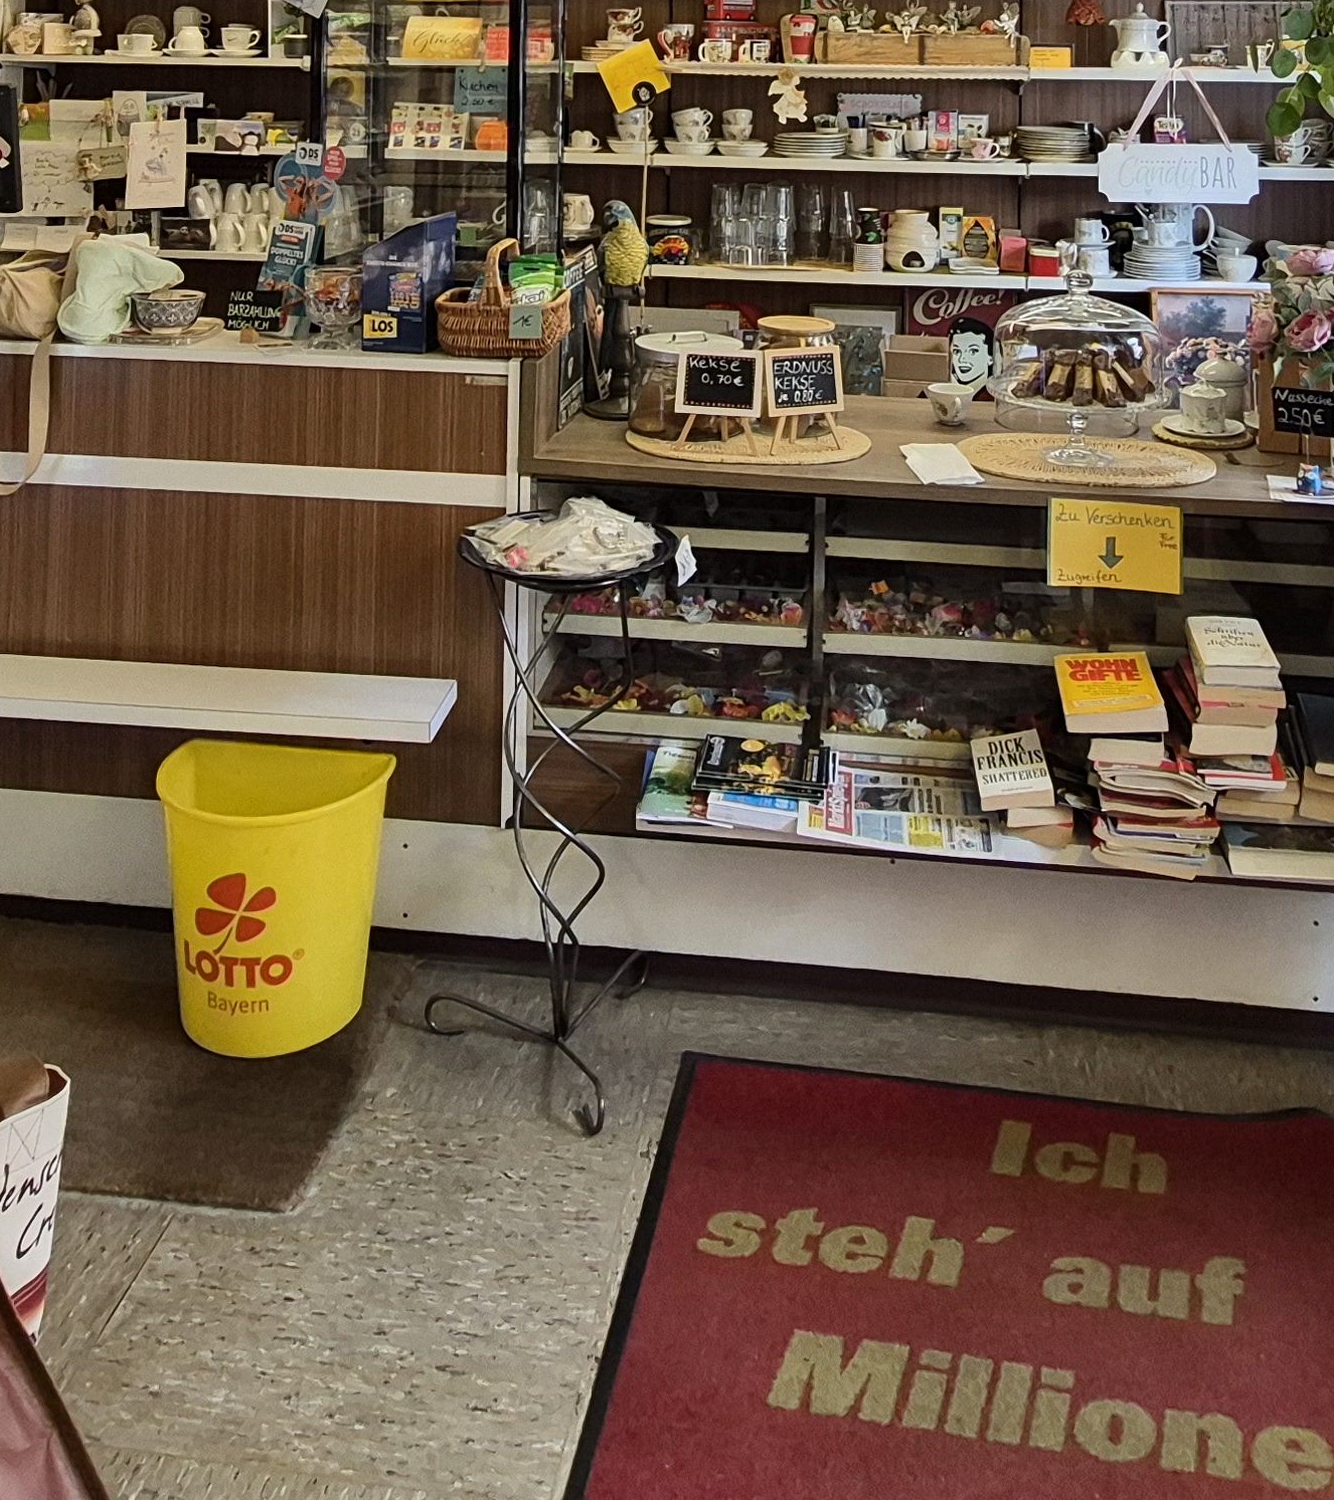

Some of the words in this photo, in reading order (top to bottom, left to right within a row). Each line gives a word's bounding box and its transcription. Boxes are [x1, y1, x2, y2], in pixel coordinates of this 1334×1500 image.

[458, 76, 500, 94] Kuchen
[308, 147, 319, 158] DS
[1200, 157, 1237, 188] BAR
[231, 291, 254, 301] NUR
[912, 288, 1003, 326] Coffee!
[371, 320, 393, 332] LOS
[513, 315, 532, 327] 1€
[689, 356, 741, 373] Kekse
[774, 361, 834, 376] ERDNUSS
[775, 375, 816, 390] KEKSE
[777, 393, 789, 403] je
[1056, 503, 1080, 522] Zu
[1086, 506, 1175, 529] Verschenken
[1057, 569, 1123, 584] Zugreifen
[1065, 658, 1138, 671] WOHN
[1069, 669, 1142, 682] GIFTE
[988, 737, 1024, 755] DICK
[977, 749, 1044, 770] FRANCIS
[982, 767, 1047, 785] SHATTERED
[184, 938, 293, 989] LOTTO
[207, 991, 269, 1016] Bayern
[988, 1118, 1169, 1195] Ich
[1041, 1254, 1248, 1327] auf
